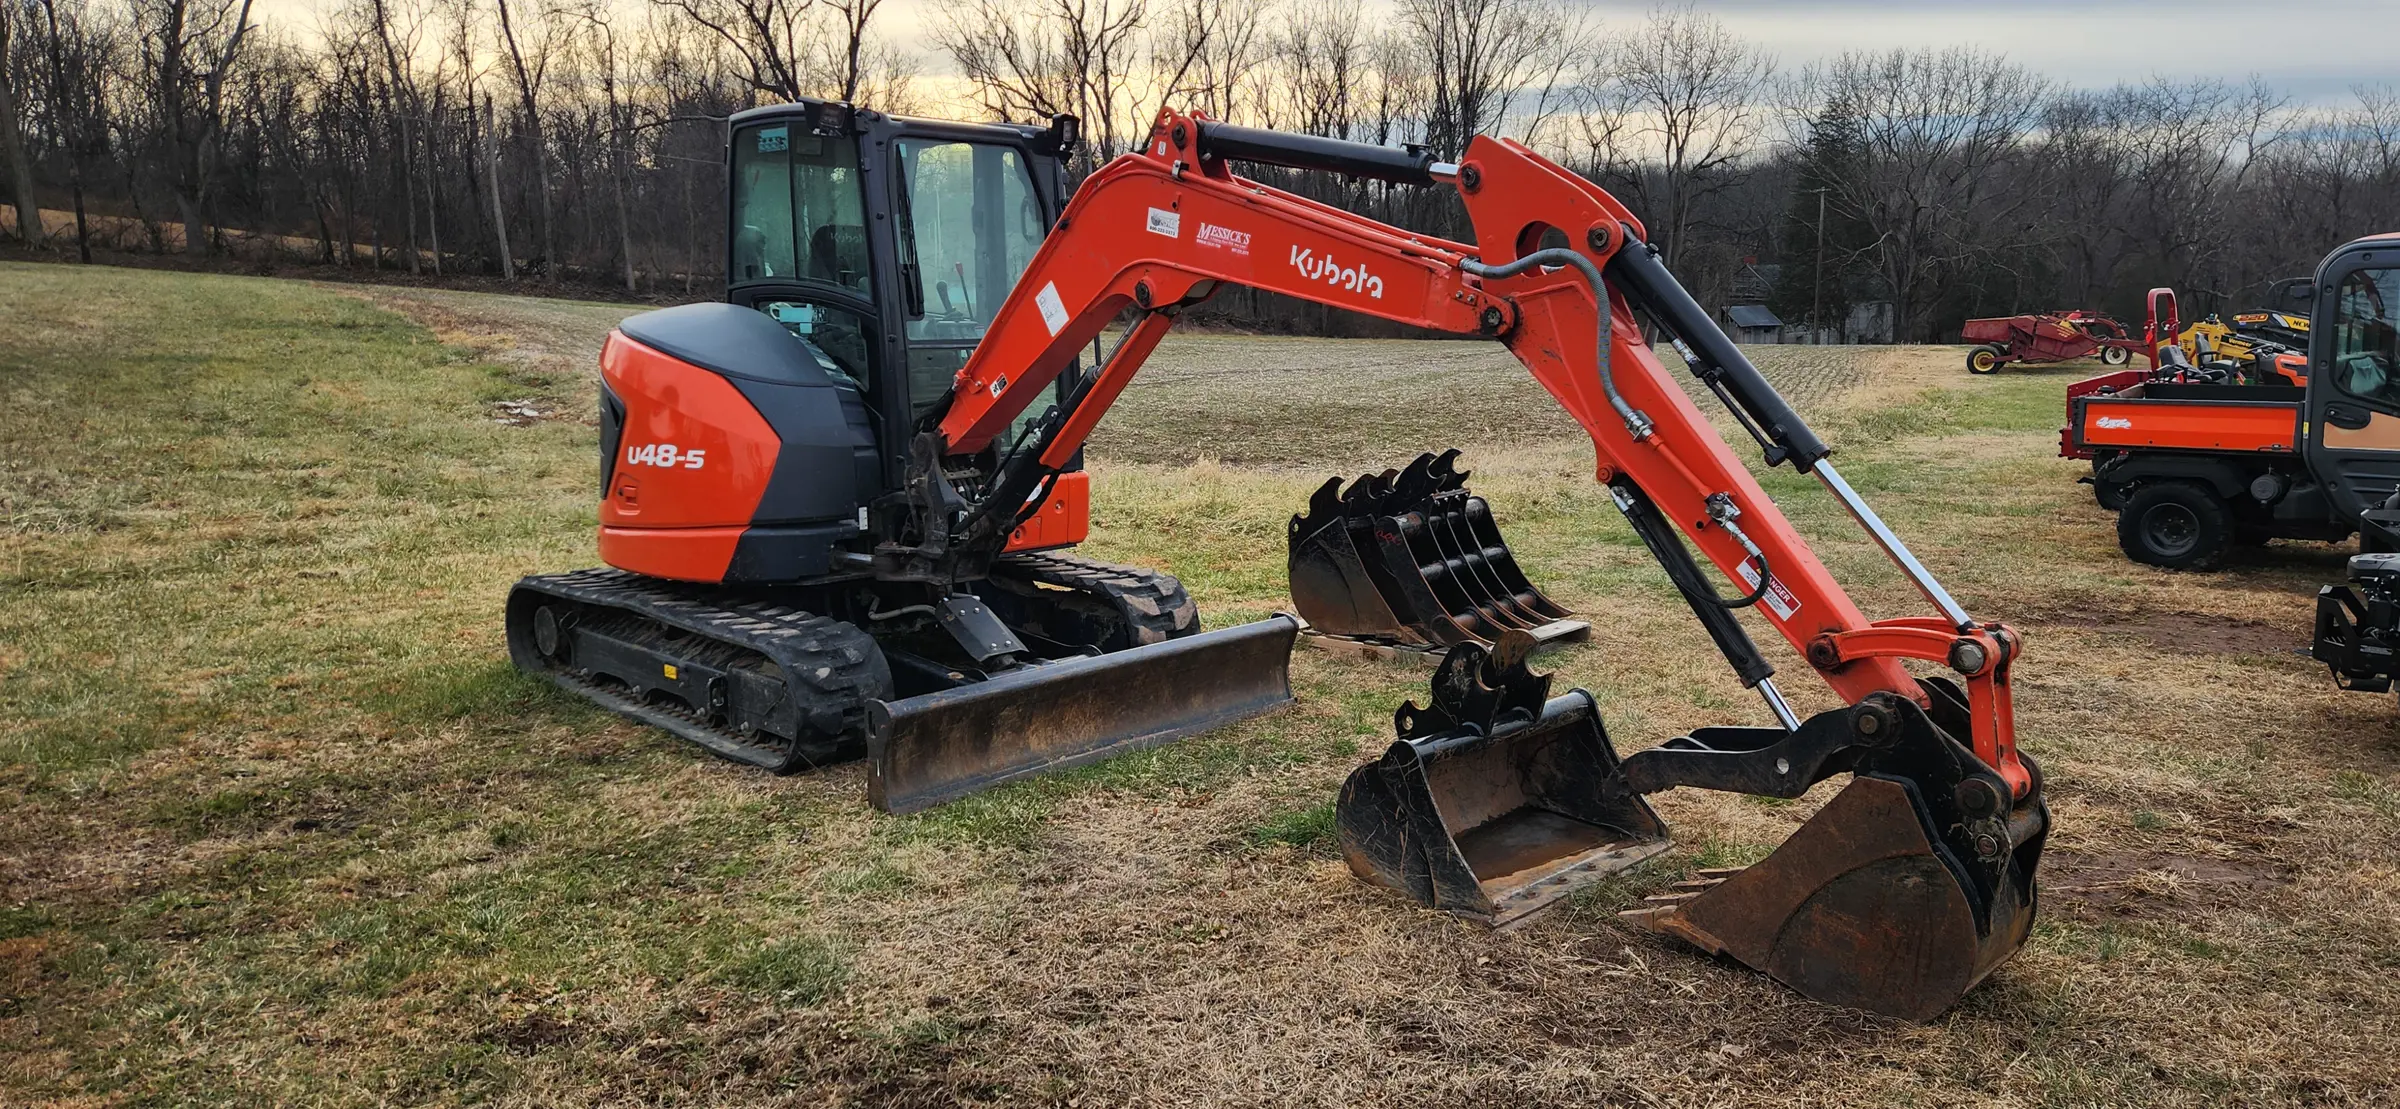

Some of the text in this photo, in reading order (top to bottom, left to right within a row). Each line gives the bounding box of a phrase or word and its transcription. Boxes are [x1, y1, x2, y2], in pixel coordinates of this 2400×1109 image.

[1196, 221, 1251, 245] MESSICK'S
[1289, 244, 1383, 299] Kubota
[627, 443, 706, 469] U48-5
[1768, 576, 1791, 602] ANGER
